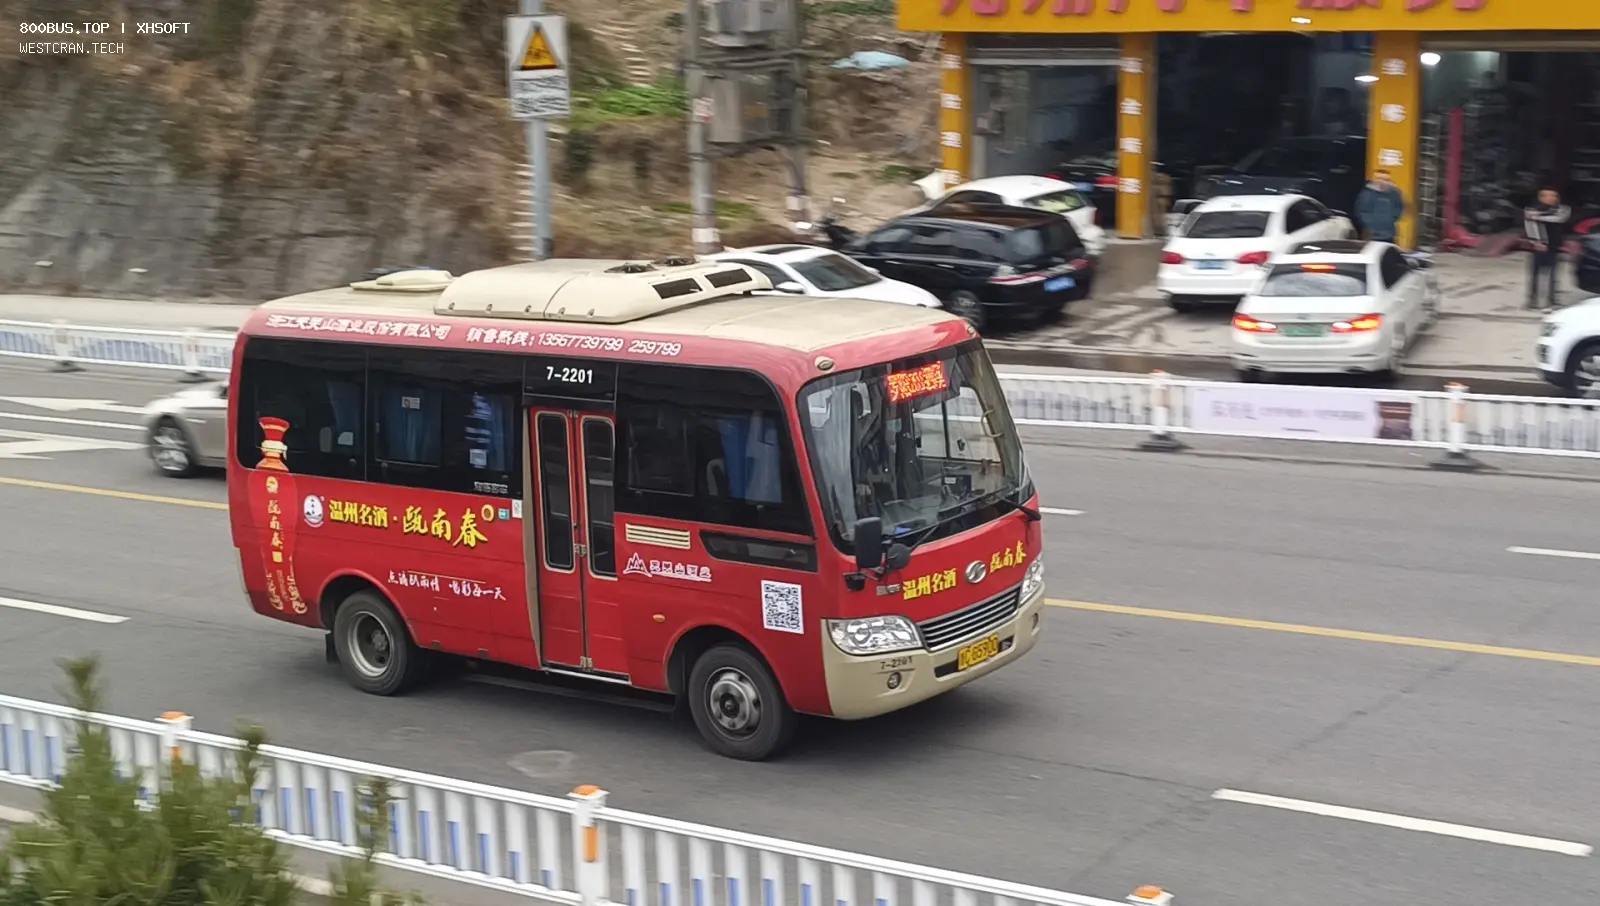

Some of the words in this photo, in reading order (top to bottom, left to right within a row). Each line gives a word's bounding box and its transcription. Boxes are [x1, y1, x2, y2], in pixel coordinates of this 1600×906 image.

[628, 339, 681, 357] 259799
[546, 366, 593, 384] 7-2201
[903, 567, 957, 600] 温州名酒
